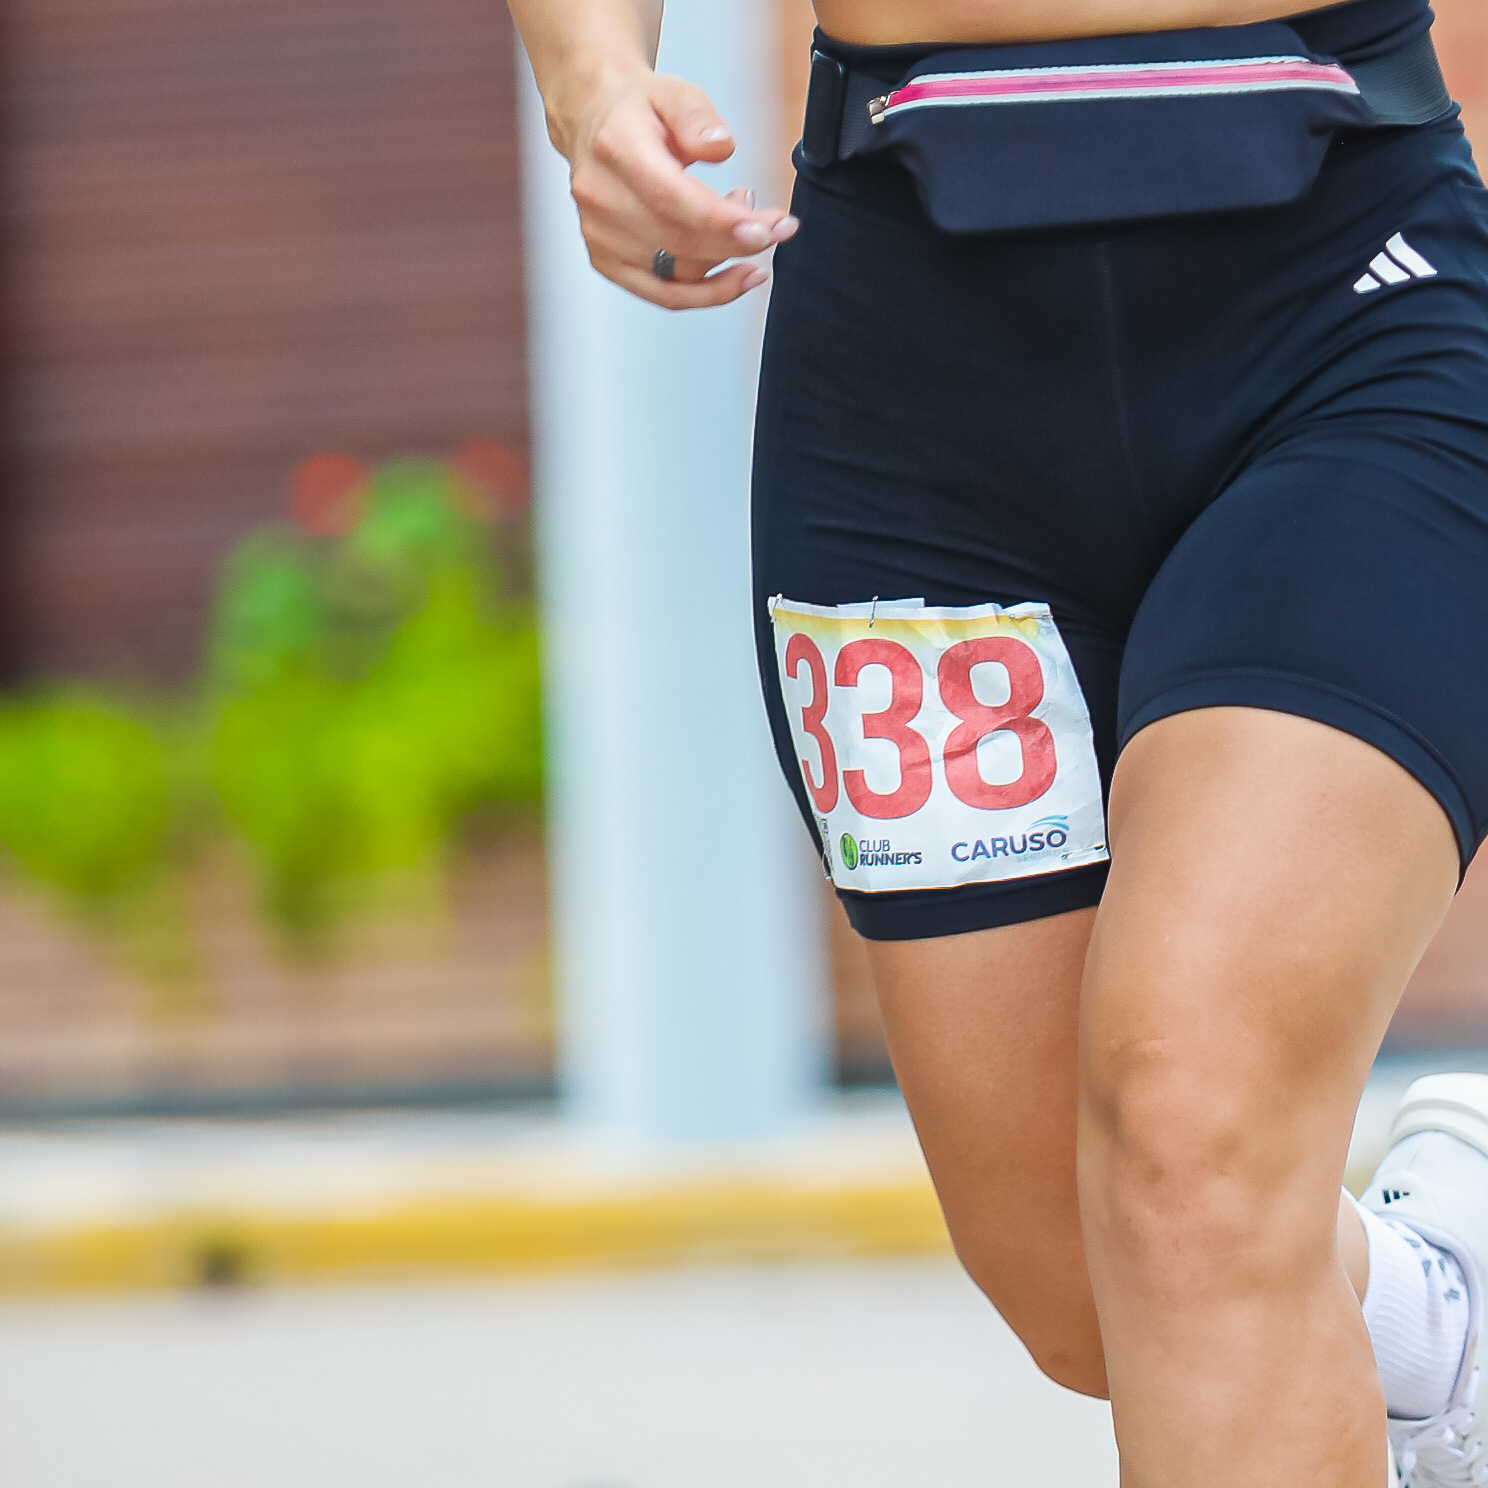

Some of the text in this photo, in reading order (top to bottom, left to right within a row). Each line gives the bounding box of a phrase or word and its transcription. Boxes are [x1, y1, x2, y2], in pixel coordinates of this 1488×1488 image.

[785, 632, 1058, 820] 338
[859, 839, 891, 853] CLUB
[951, 829, 1067, 862] CARUSO
